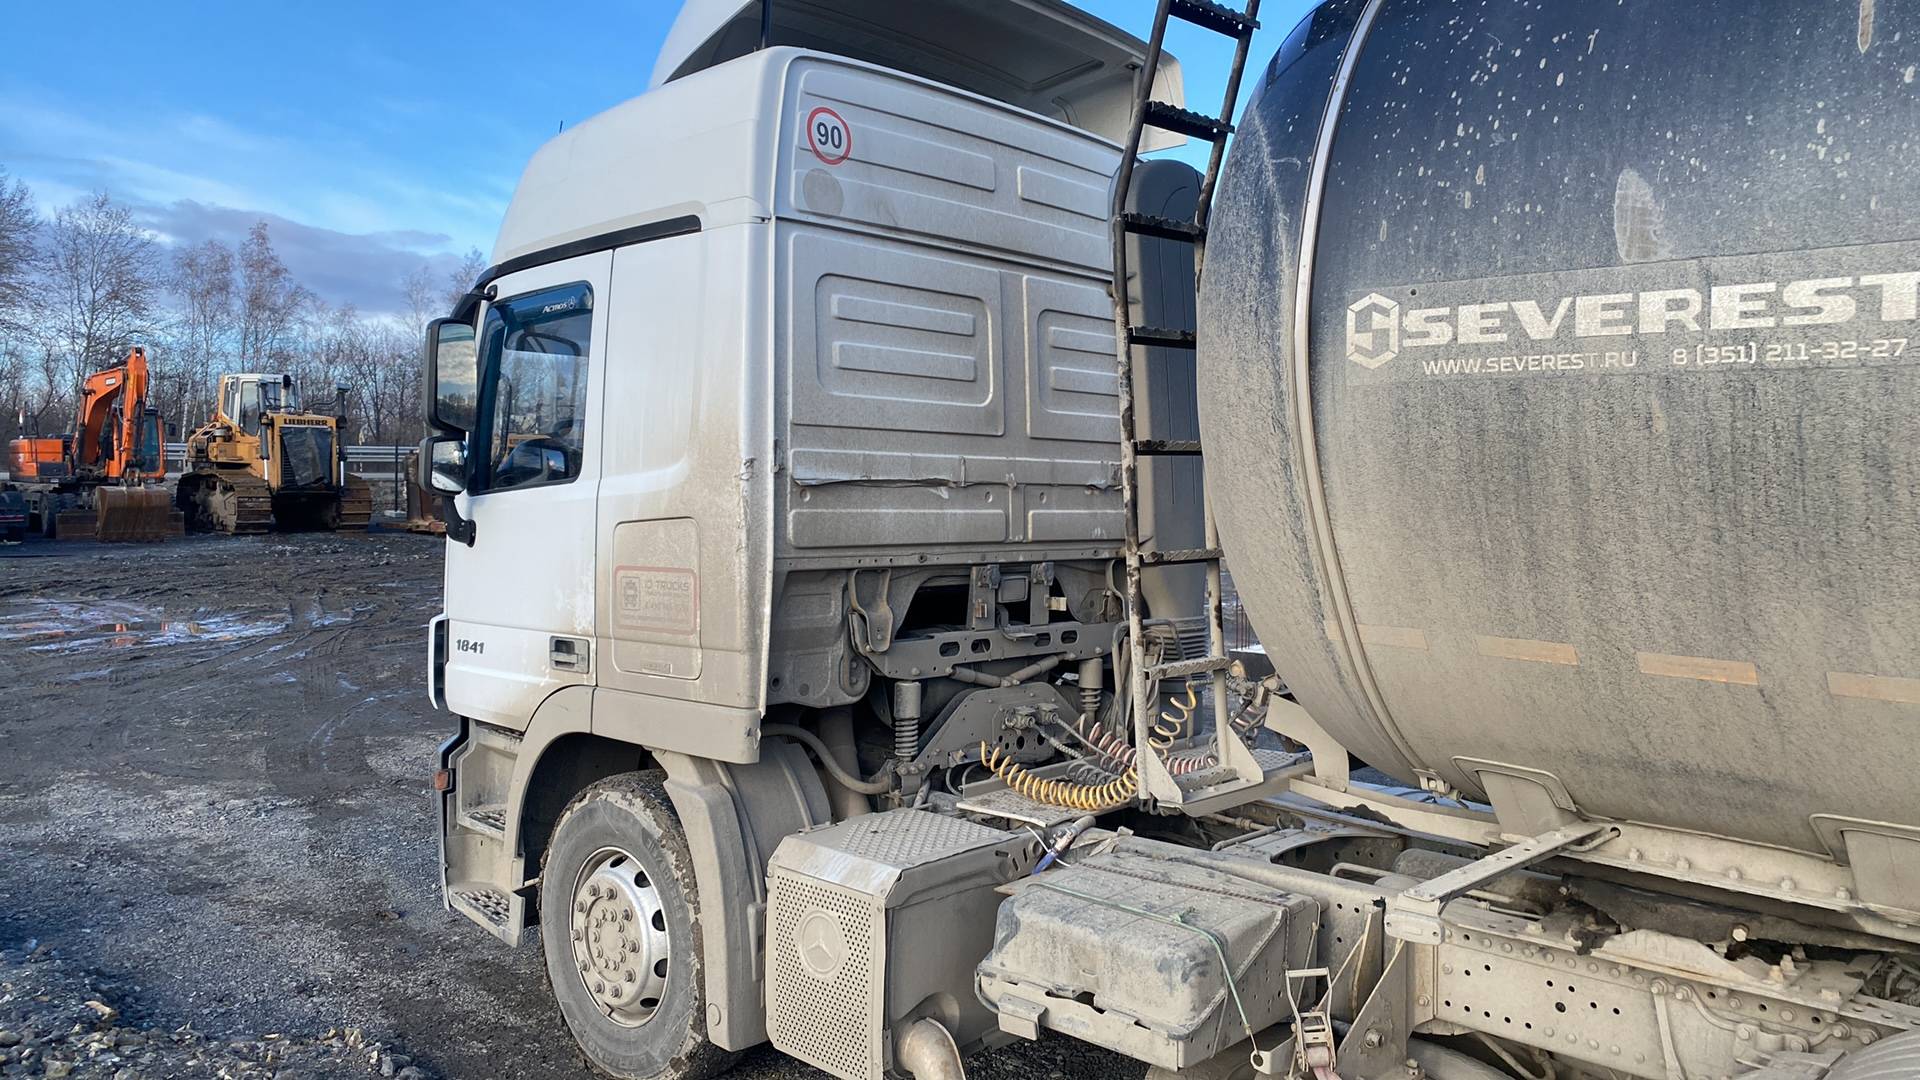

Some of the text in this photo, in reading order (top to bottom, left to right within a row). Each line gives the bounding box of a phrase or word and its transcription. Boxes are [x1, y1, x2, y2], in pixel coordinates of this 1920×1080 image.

[816, 121, 842, 149] 90
[1402, 271, 1920, 347] SEVEREST
[1423, 338, 1908, 375] WWW.SEVEREST.RU 8 (351) 211-32-27
[284, 418, 328, 426] LIEBHERR
[456, 639, 485, 654] 1841
